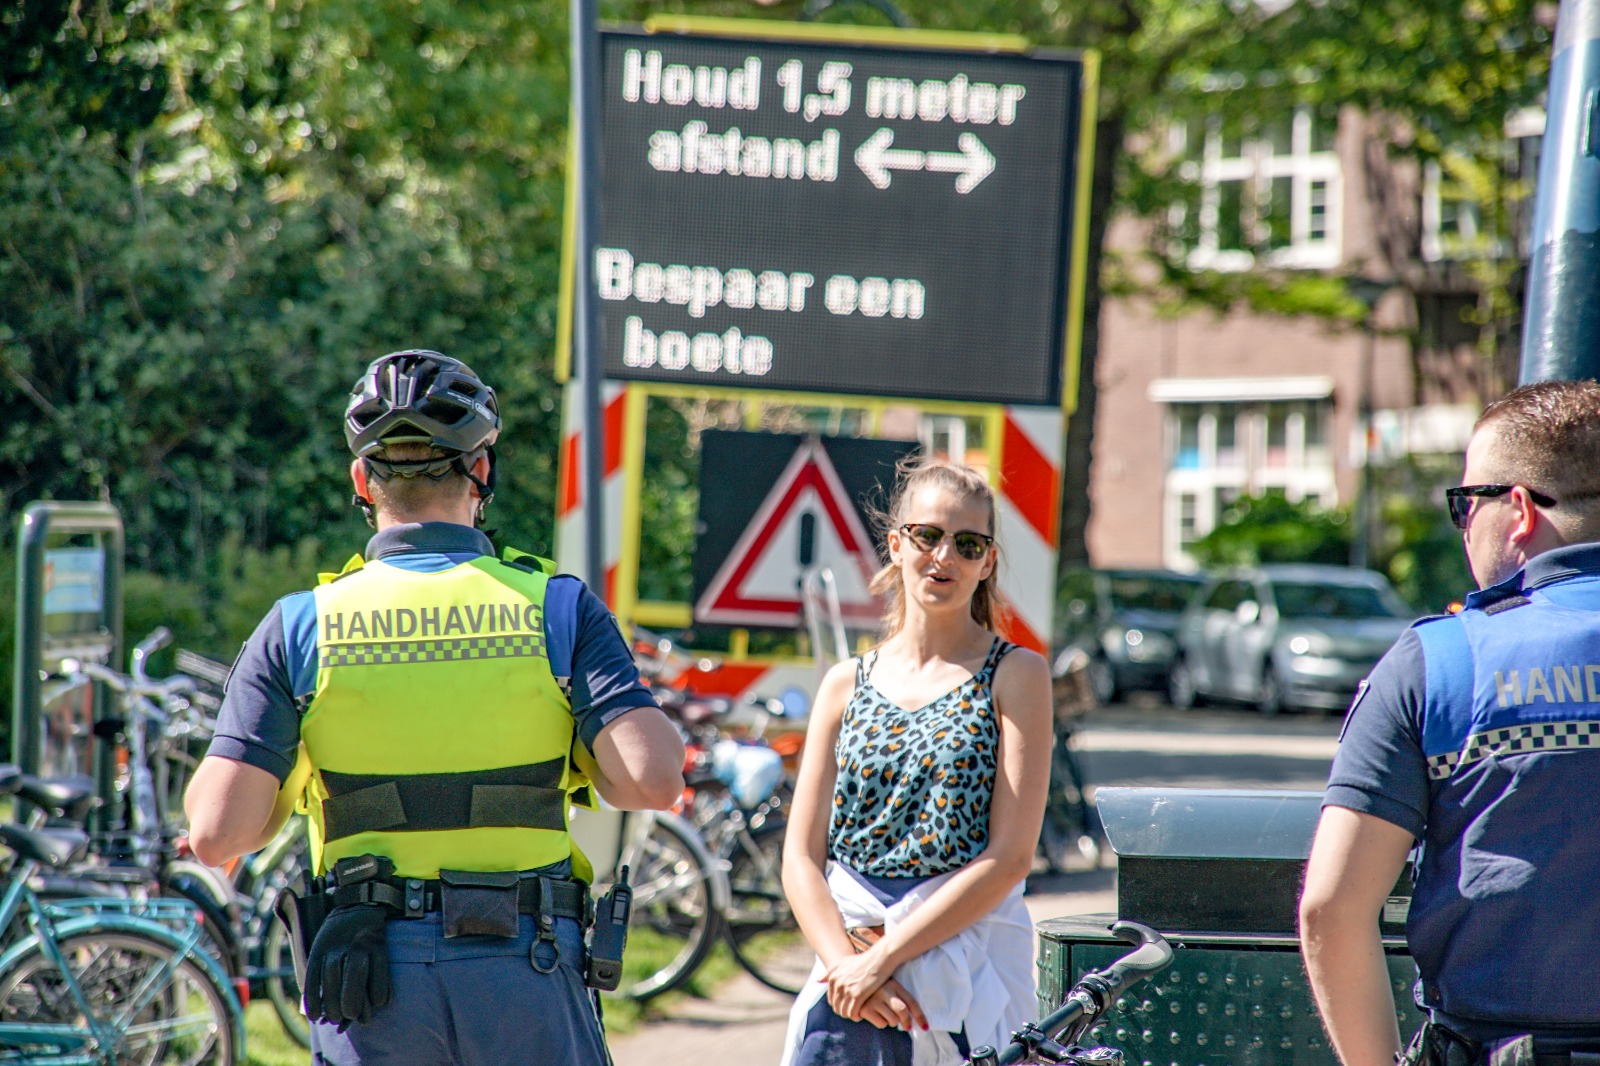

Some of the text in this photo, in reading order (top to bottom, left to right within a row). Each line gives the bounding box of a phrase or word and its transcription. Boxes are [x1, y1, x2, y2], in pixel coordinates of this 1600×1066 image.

[622, 48, 1026, 125] Houd 1,5 meter
[648, 120, 840, 182] afstand
[596, 247, 926, 319] Bespaar een
[623, 316, 773, 375] boete
[325, 603, 543, 641] HANDHAVING
